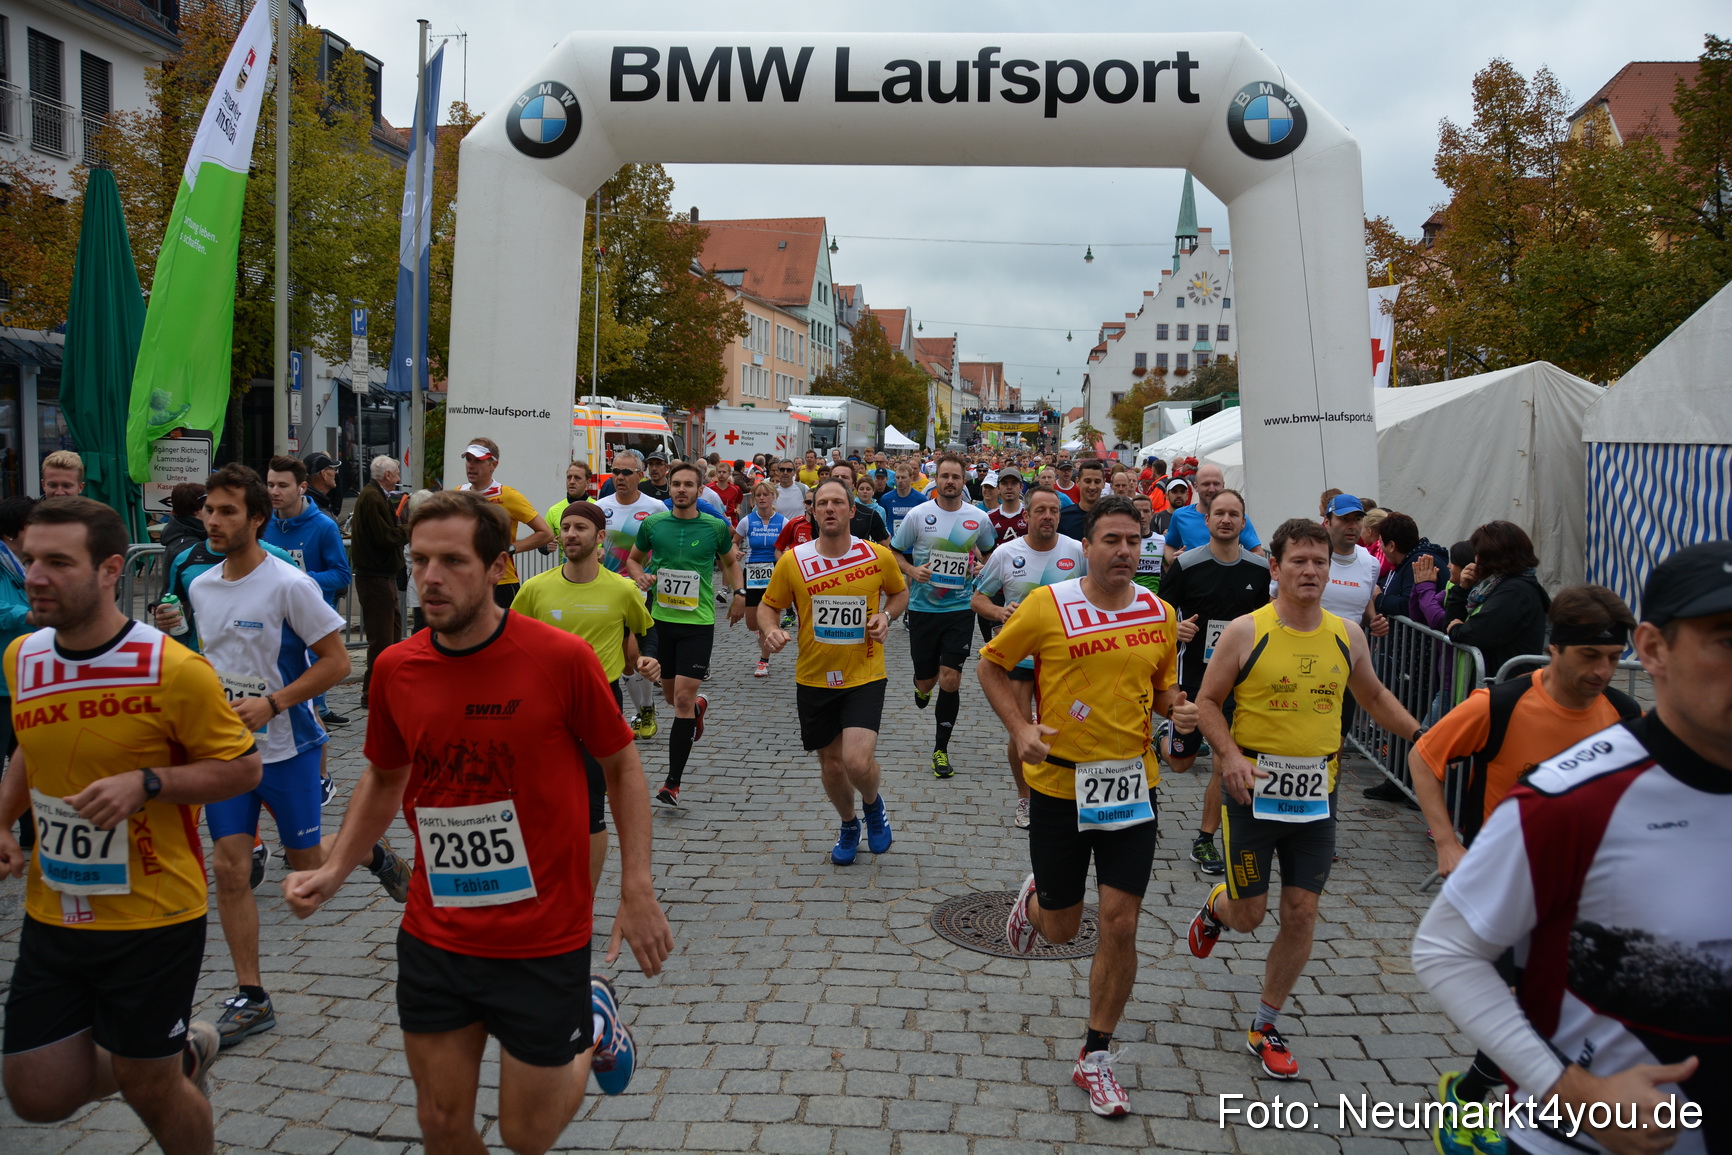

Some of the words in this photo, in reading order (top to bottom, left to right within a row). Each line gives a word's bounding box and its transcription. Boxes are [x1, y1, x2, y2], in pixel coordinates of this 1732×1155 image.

[610, 46, 814, 102] BMW
[834, 46, 1200, 118] Laufsport
[516, 82, 577, 108] BMW
[1234, 82, 1299, 109] BMW
[316, 404, 322, 417] 3
[448, 405, 551, 419] www.bmw-laufsport.de
[1264, 411, 1373, 426] www.bmw-laufsport.de
[180, 446, 207, 455] Richtung
[154, 465, 184, 473] Kreuzung
[749, 568, 773, 580] 2820
[933, 559, 965, 575] 2126
[664, 579, 691, 596] 377
[807, 577, 842, 596] MAX
[845, 565, 882, 583] BÖGL
[938, 576, 957, 584] Timmy
[1331, 579, 1361, 588] KLEBL
[667, 597, 685, 605] Tobias
[818, 607, 862, 626] 2760
[824, 629, 855, 638] Matthias
[1068, 636, 1120, 659] MAX
[1124, 628, 1167, 648] BÖGL
[225, 678, 256, 690] Neumarkt
[465, 704, 502, 715] swn
[1269, 700, 1279, 708] M
[1281, 700, 1290, 708] &
[1292, 700, 1298, 708] S
[15, 702, 69, 731] MAX
[78, 693, 162, 719] BÖGL
[1077, 767, 1104, 775] PARTL
[1105, 764, 1134, 775] Neumarkt
[1258, 760, 1283, 769] PARTL
[1084, 773, 1142, 804] 2787
[1263, 771, 1323, 798] 2682
[1097, 809, 1135, 821] Dietmar
[1277, 802, 1305, 813] Klaus
[418, 817, 446, 828] PARTL
[447, 813, 497, 827] Neumarkt
[305, 825, 320, 834] JAKO
[38, 816, 117, 860] 2767
[429, 827, 515, 869] 2385
[47, 863, 101, 882] Andreas
[1243, 852, 1259, 880] Run!
[454, 877, 500, 893] Fabian
